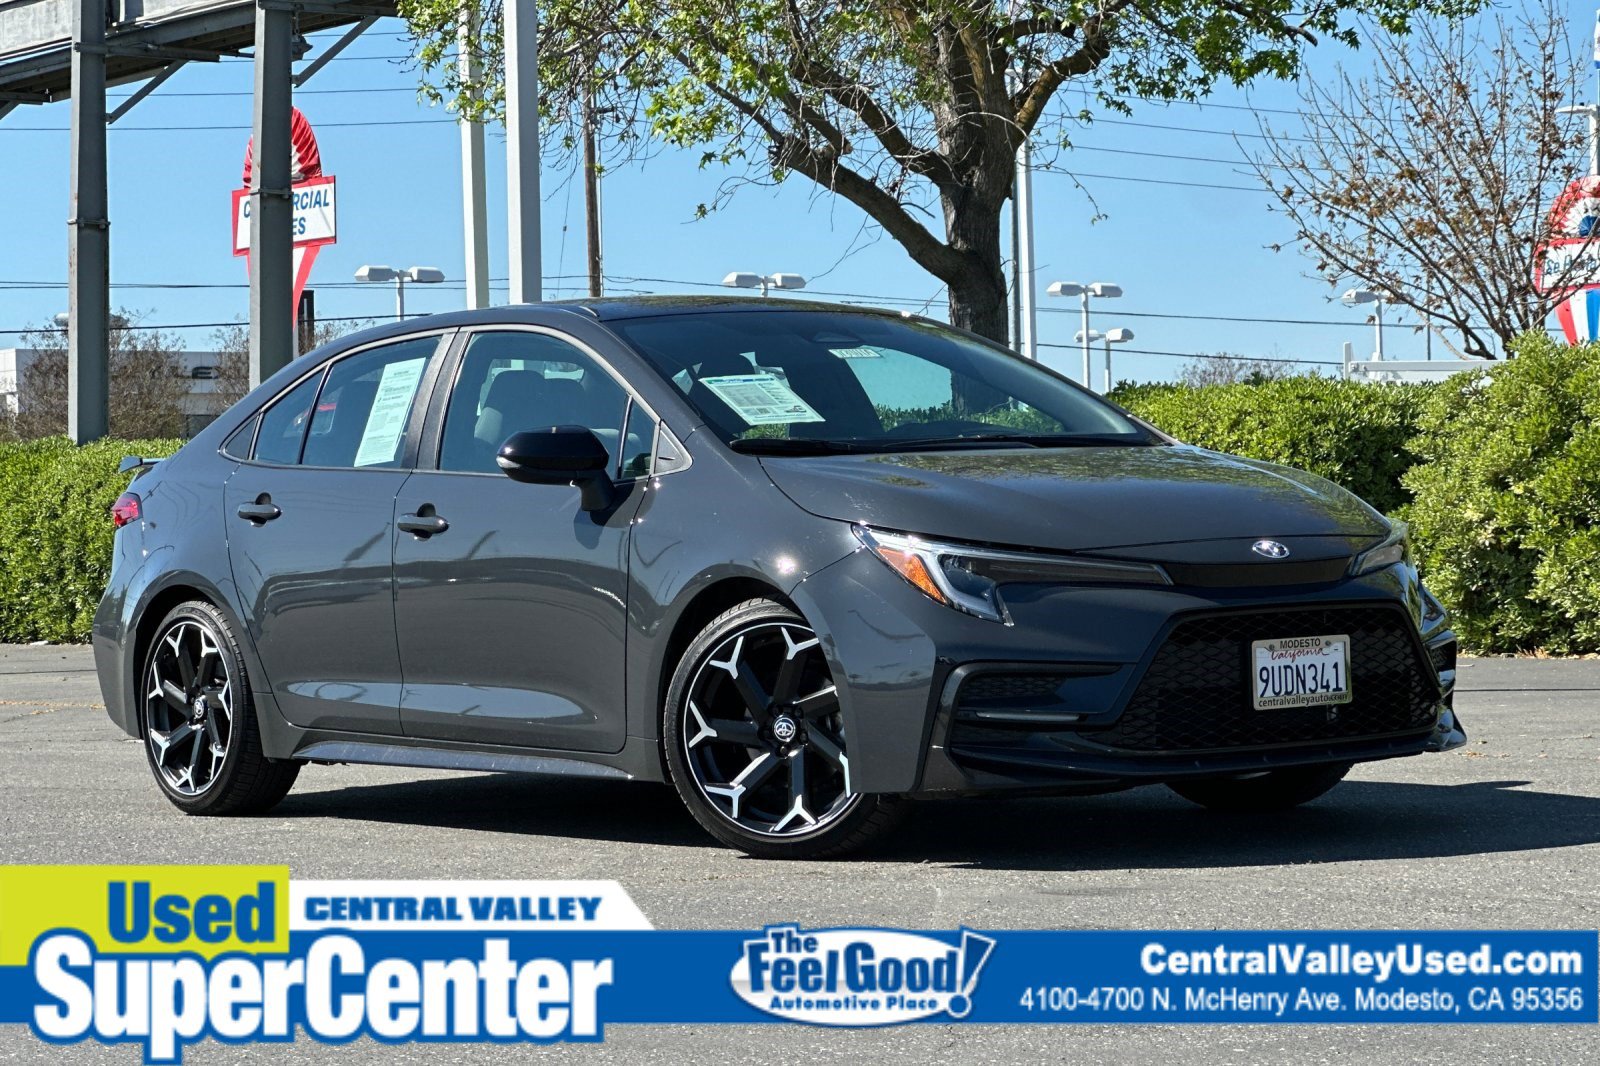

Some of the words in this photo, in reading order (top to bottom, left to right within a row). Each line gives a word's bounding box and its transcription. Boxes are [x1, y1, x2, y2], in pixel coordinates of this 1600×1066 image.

[243, 188, 330, 219] CRCIAL
[1279, 638, 1321, 650] MODESTO
[1268, 647, 1330, 663] California
[1259, 661, 1343, 698] 9UDN341
[1258, 694, 1348, 707] centralvalleyauto.com
